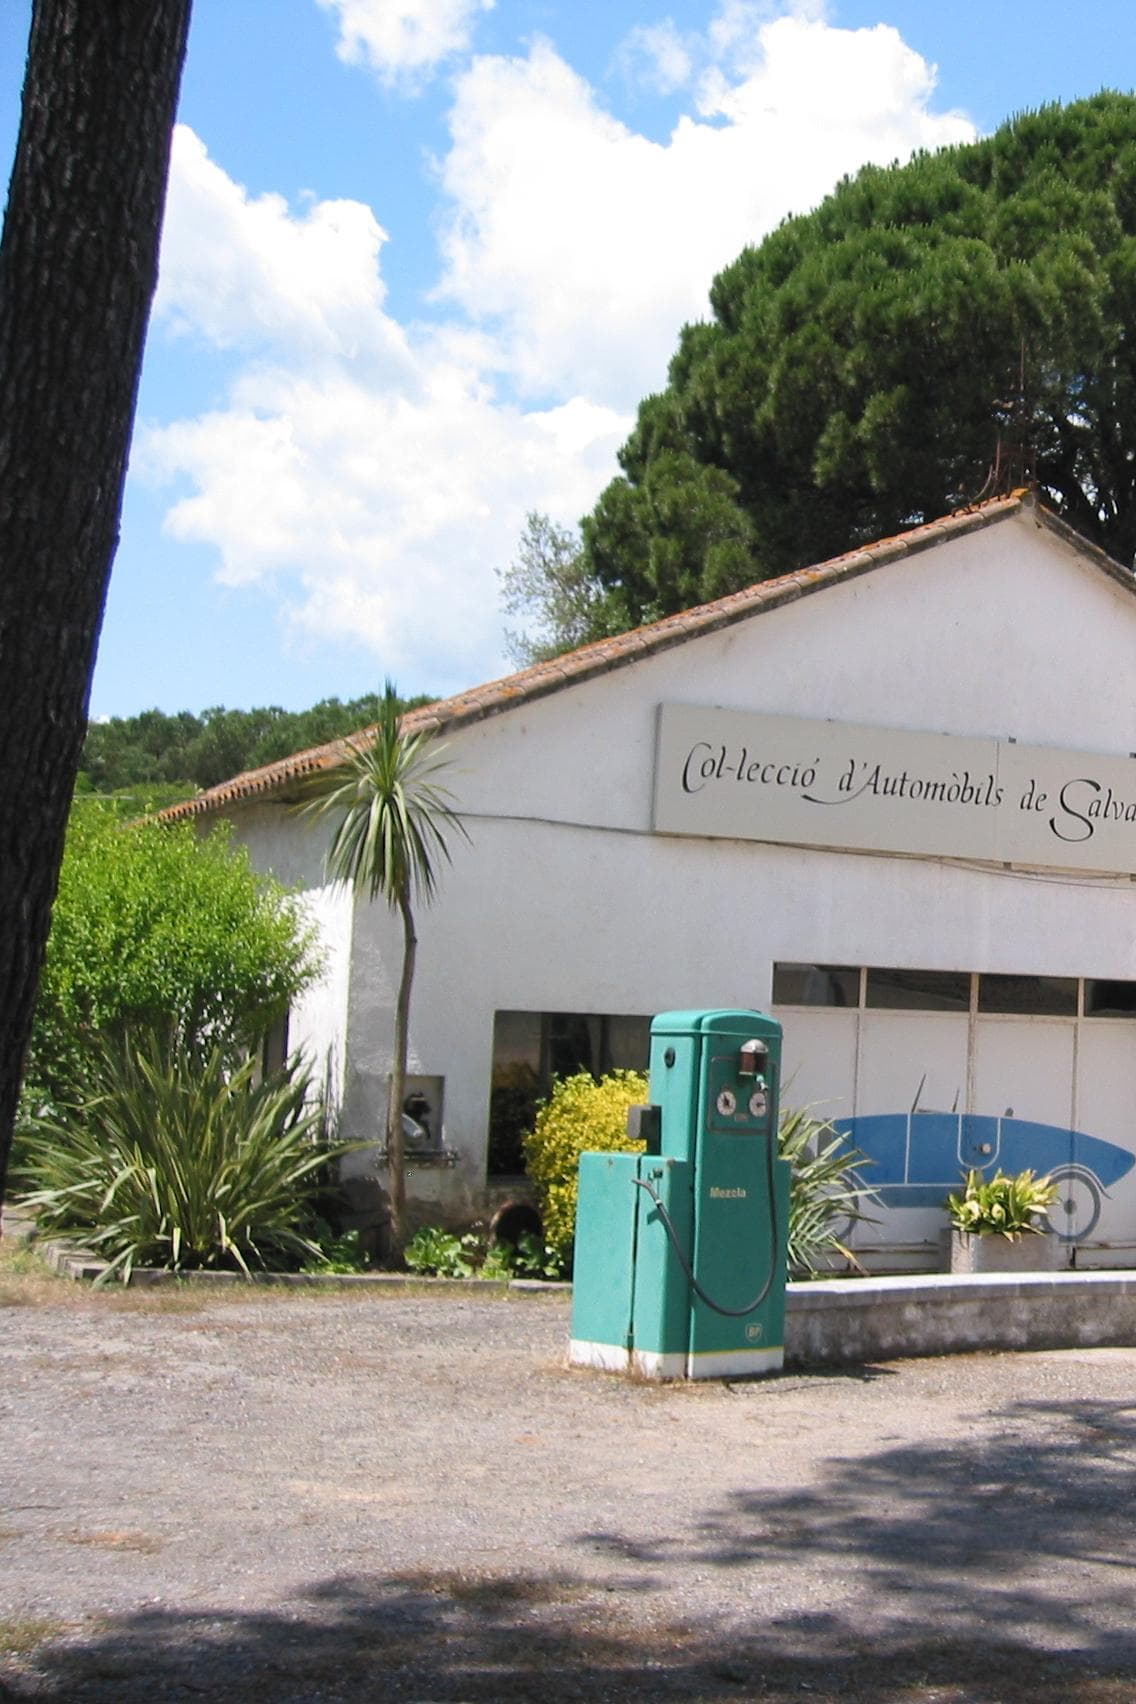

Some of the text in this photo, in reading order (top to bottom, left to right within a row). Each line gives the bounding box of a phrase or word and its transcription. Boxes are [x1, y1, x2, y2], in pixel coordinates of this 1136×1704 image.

[801, 758, 1004, 807] d'Automòbils
[1020, 779, 1047, 812] de
[710, 1187, 746, 1199] Mezcla
